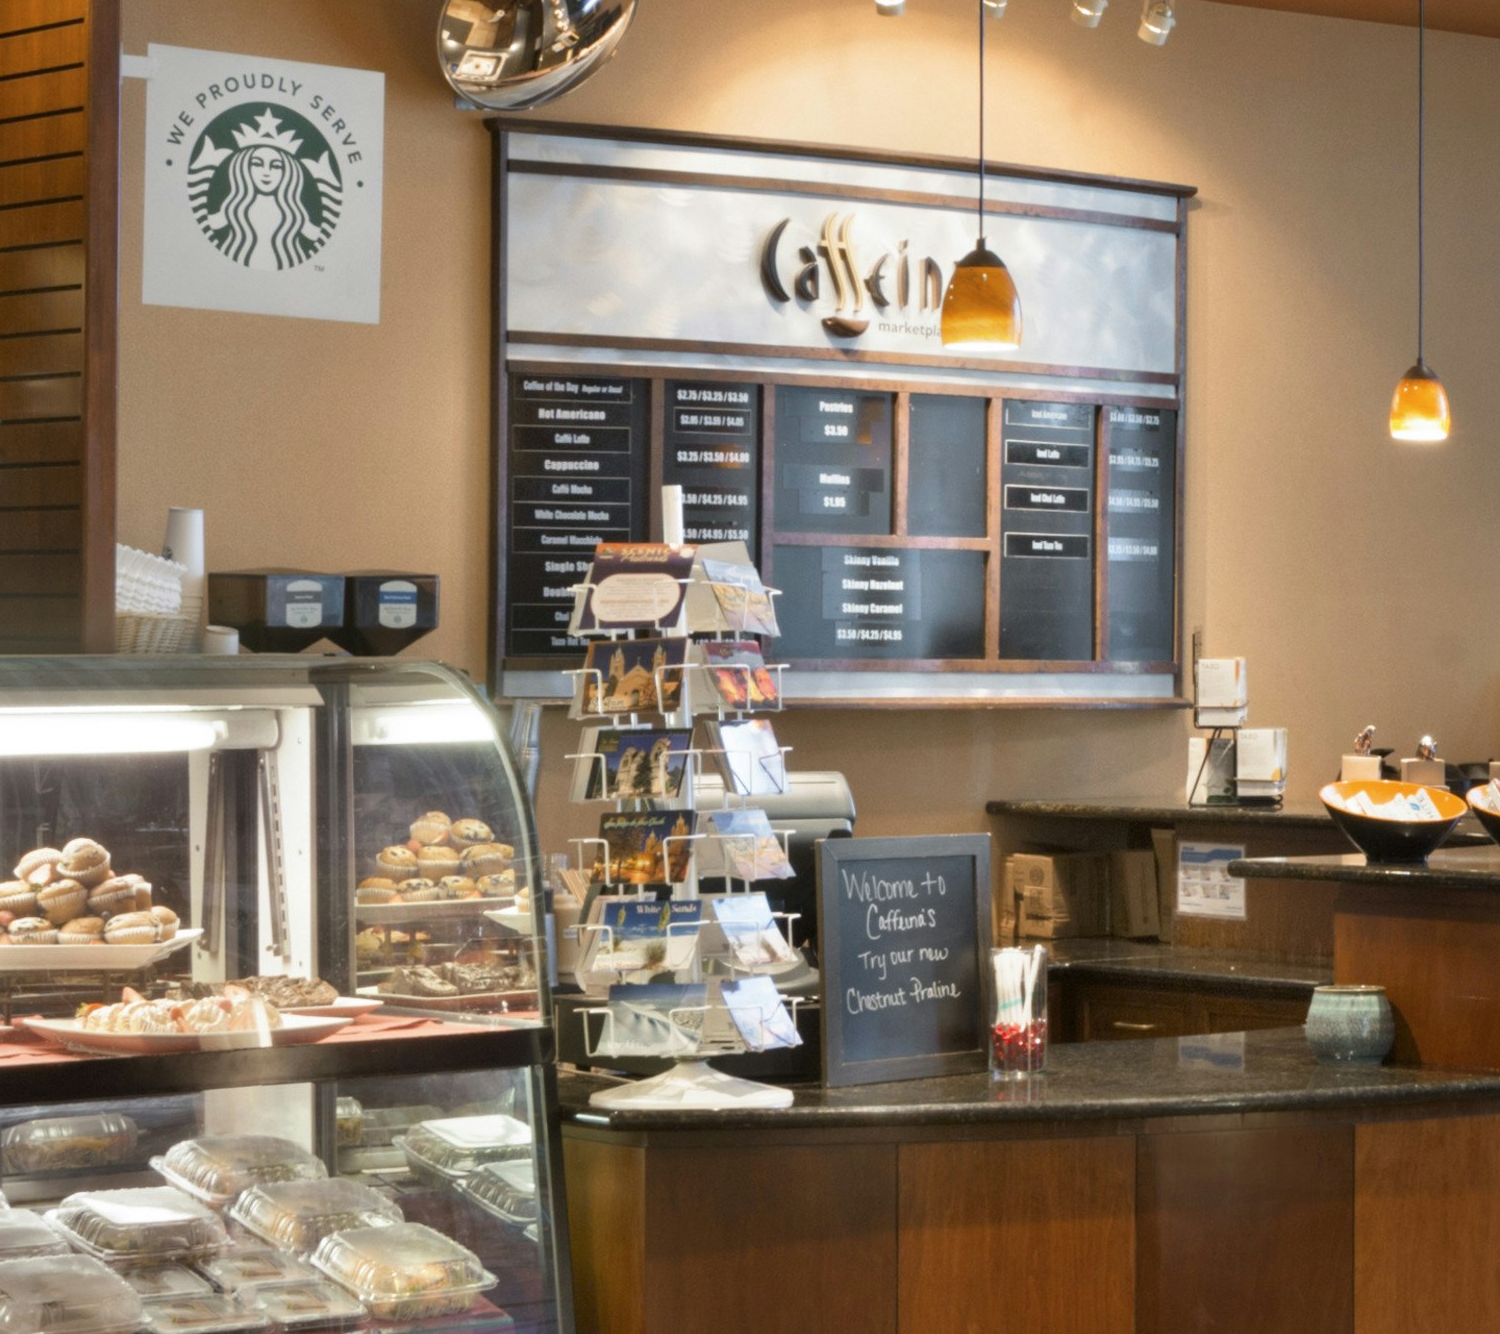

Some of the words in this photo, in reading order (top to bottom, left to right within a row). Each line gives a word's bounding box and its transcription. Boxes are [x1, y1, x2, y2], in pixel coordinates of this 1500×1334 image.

[167, 110, 195, 146] WE
[195, 73, 303, 109] PROUDLY
[309, 94, 363, 165] SERVE
[538, 408, 555, 419] Hot
[556, 408, 606, 421] Americano
[819, 401, 854, 414] Pastries
[544, 459, 600, 471] Cappuccino
[545, 561, 575, 573] Single
[841, 868, 918, 902] Welcome
[920, 871, 946, 895] to
[858, 950, 887, 980] Try
[890, 950, 914, 965] our
[919, 947, 949, 961] new
[846, 987, 907, 1015] Chestnut
[910, 976, 961, 1003] Praline
